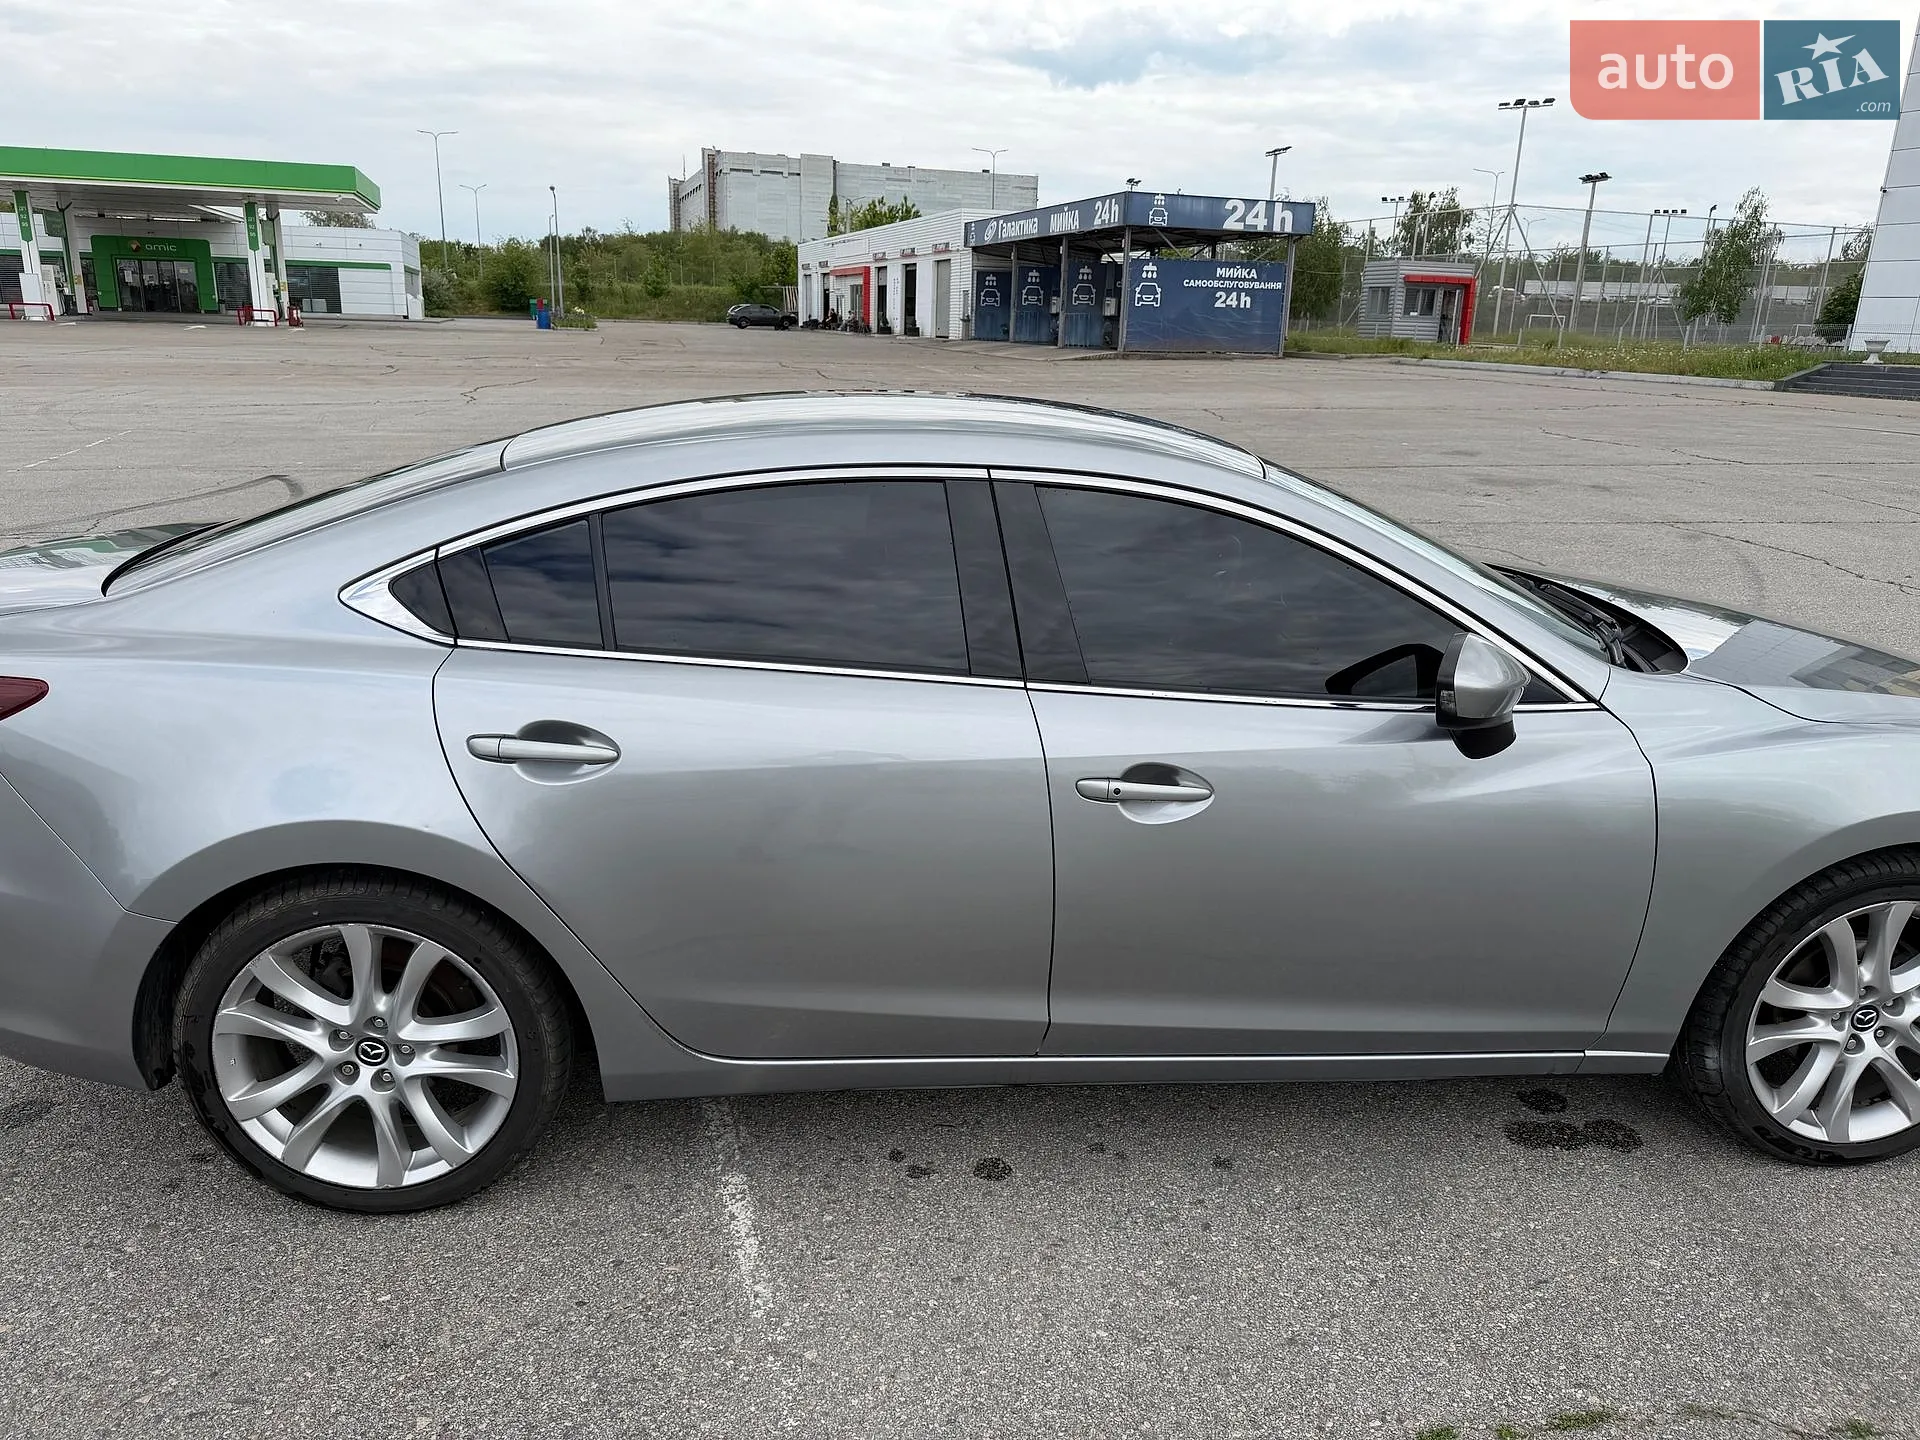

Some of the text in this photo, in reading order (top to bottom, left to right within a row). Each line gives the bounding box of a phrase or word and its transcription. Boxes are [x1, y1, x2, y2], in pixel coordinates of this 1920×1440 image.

[998, 217, 1038, 239] Галактика
[1050, 206, 1079, 233] МИЙКА
[1216, 265, 1258, 279] МИЙКА
[1183, 279, 1282, 290] САМООБСЛУГОВУВАННЯ
